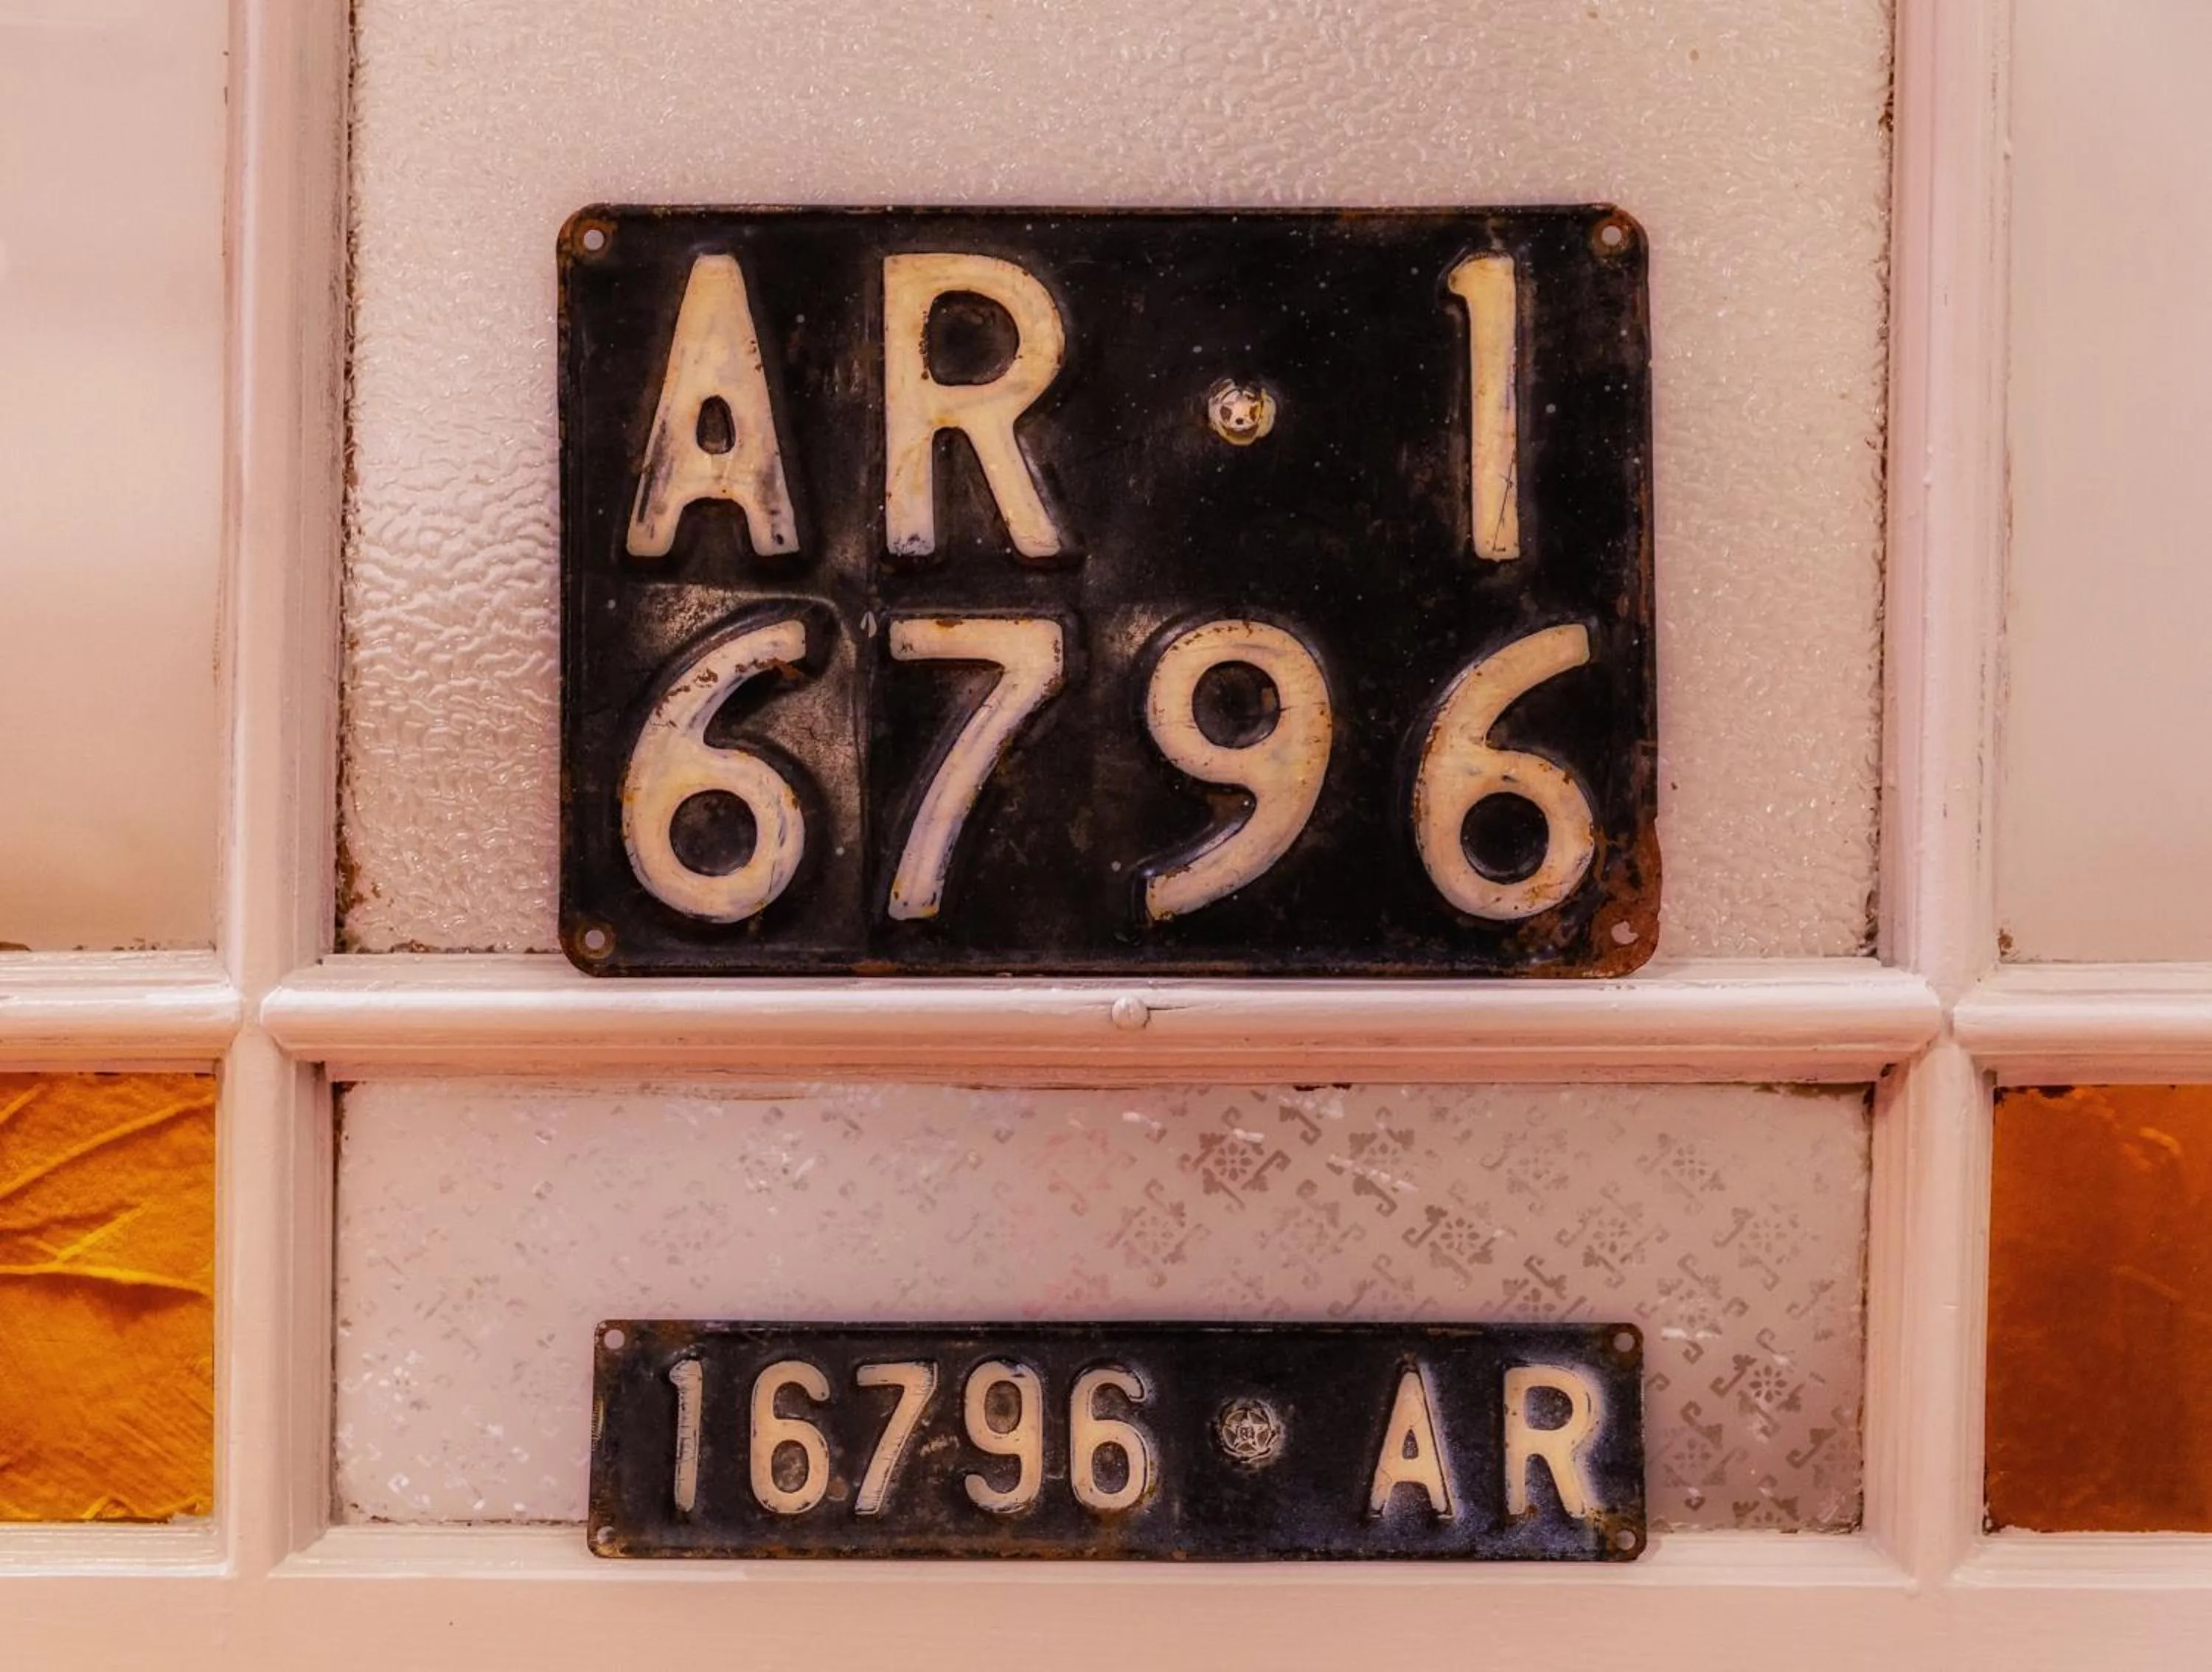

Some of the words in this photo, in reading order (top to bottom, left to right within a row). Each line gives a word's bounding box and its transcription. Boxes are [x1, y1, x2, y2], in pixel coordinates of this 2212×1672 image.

[626, 252, 1066, 558] AR
[1447, 252, 1521, 560] 1
[623, 618, 1596, 924] 6796
[668, 1359, 1158, 1516] 16796
[1368, 1364, 1600, 1519] AR
